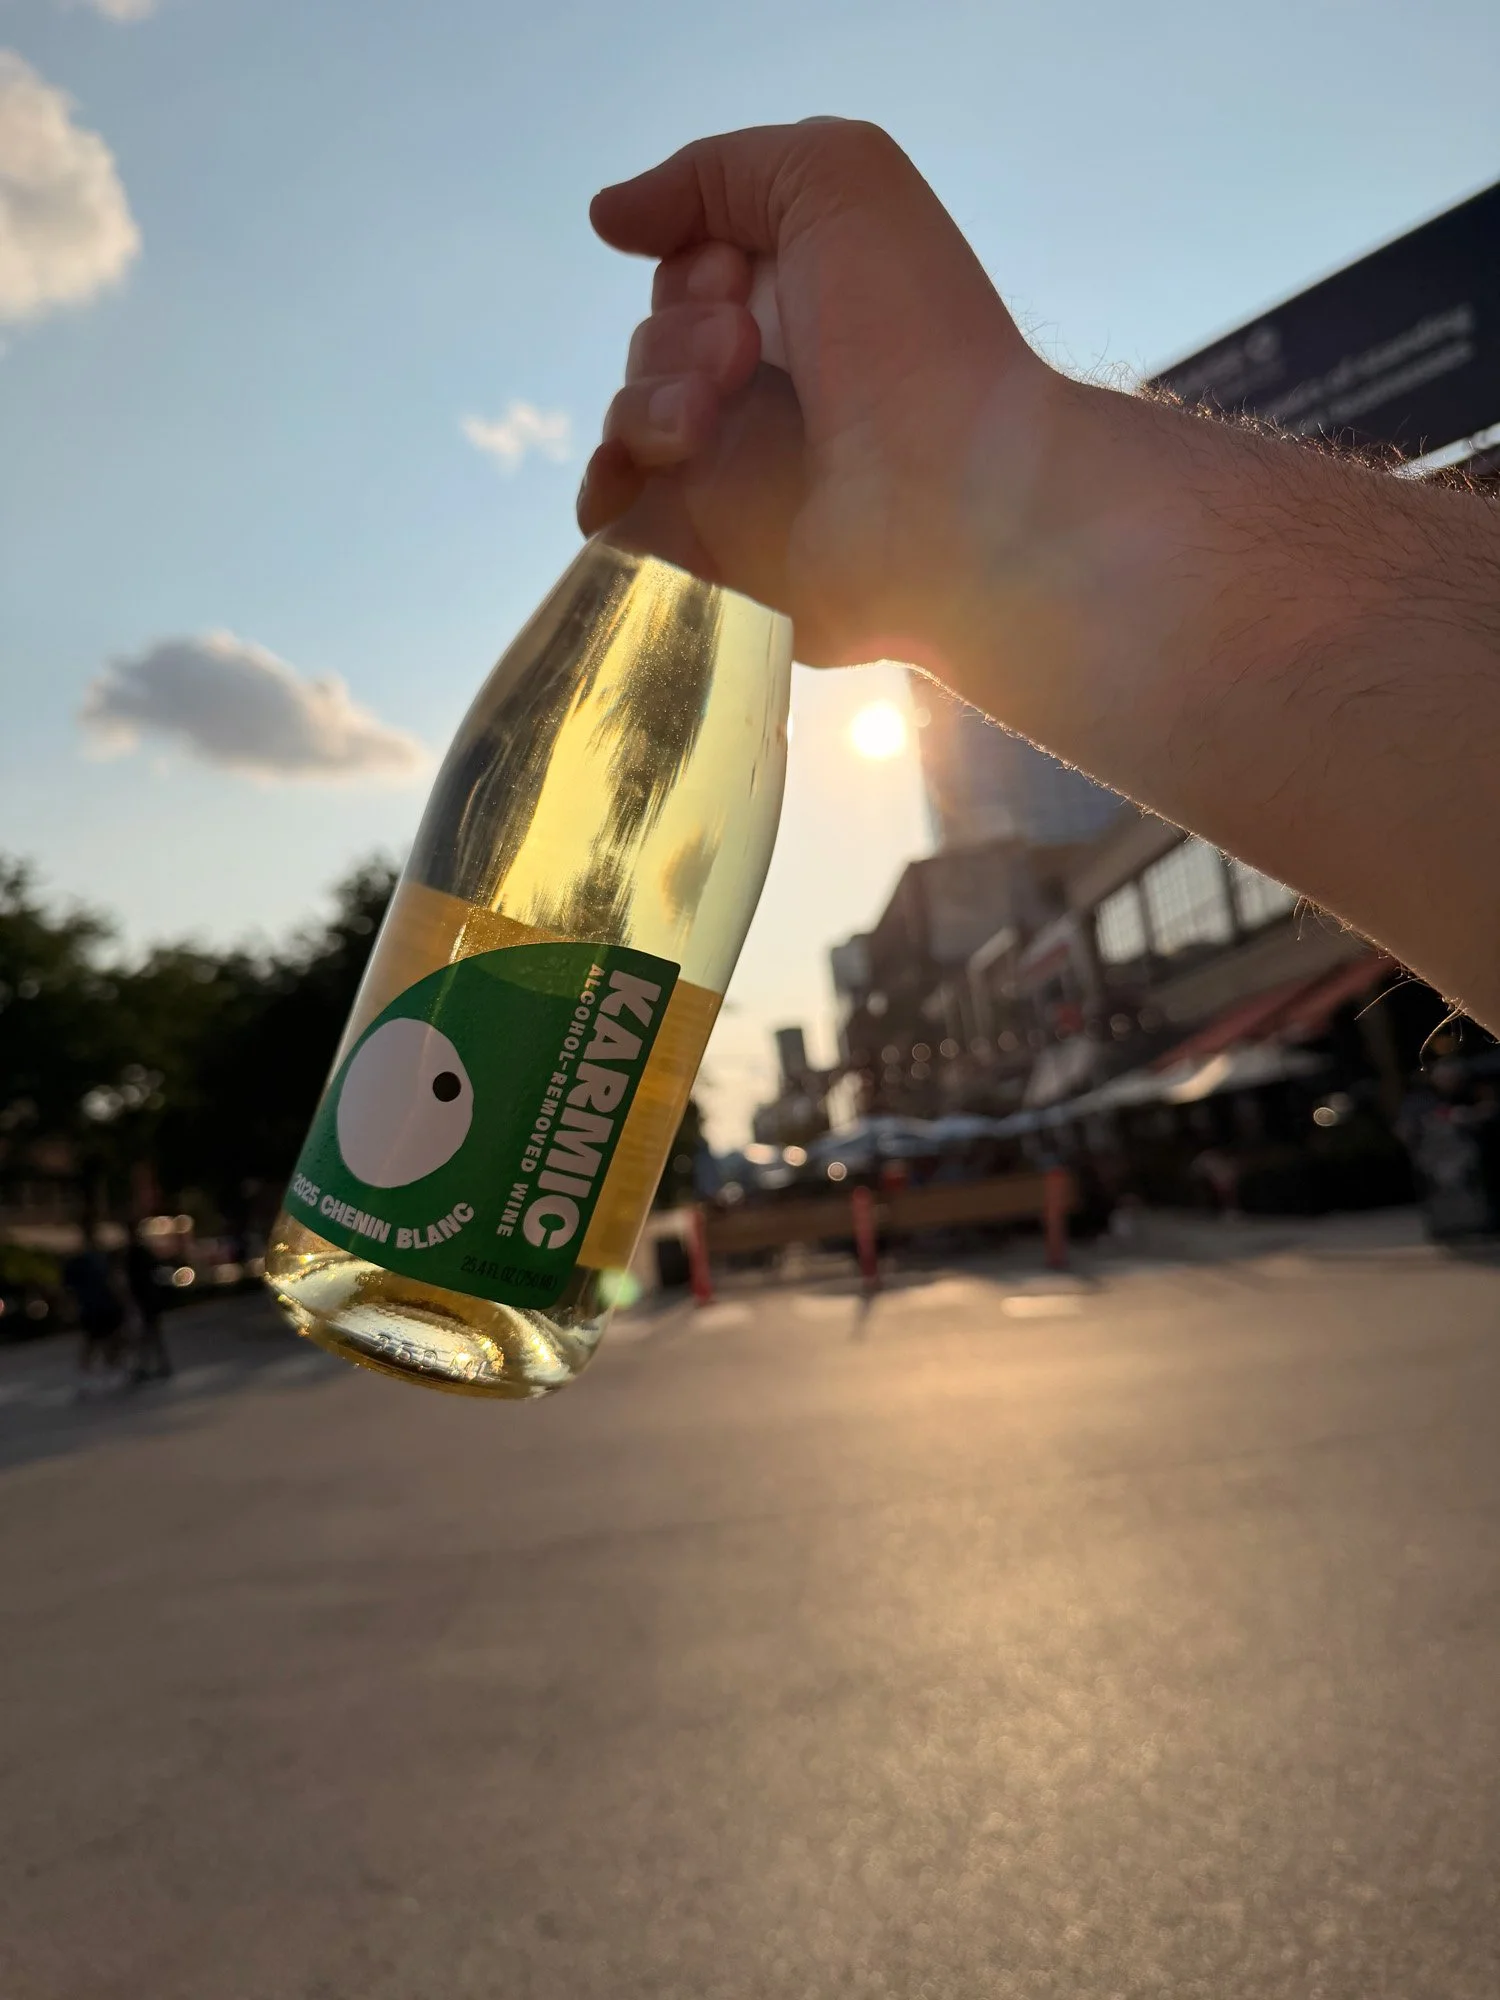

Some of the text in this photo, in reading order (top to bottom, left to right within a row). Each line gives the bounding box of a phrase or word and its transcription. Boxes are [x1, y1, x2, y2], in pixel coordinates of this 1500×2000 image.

[496, 963, 605, 1237] ALCOHOL-REMOVED WINE
[522, 970, 662, 1250] KARMIC
[293, 1173, 475, 1249] 2025 CHENIN BLANC
[461, 1255, 487, 1276] 25.4
[486, 1262, 499, 1280] FL
